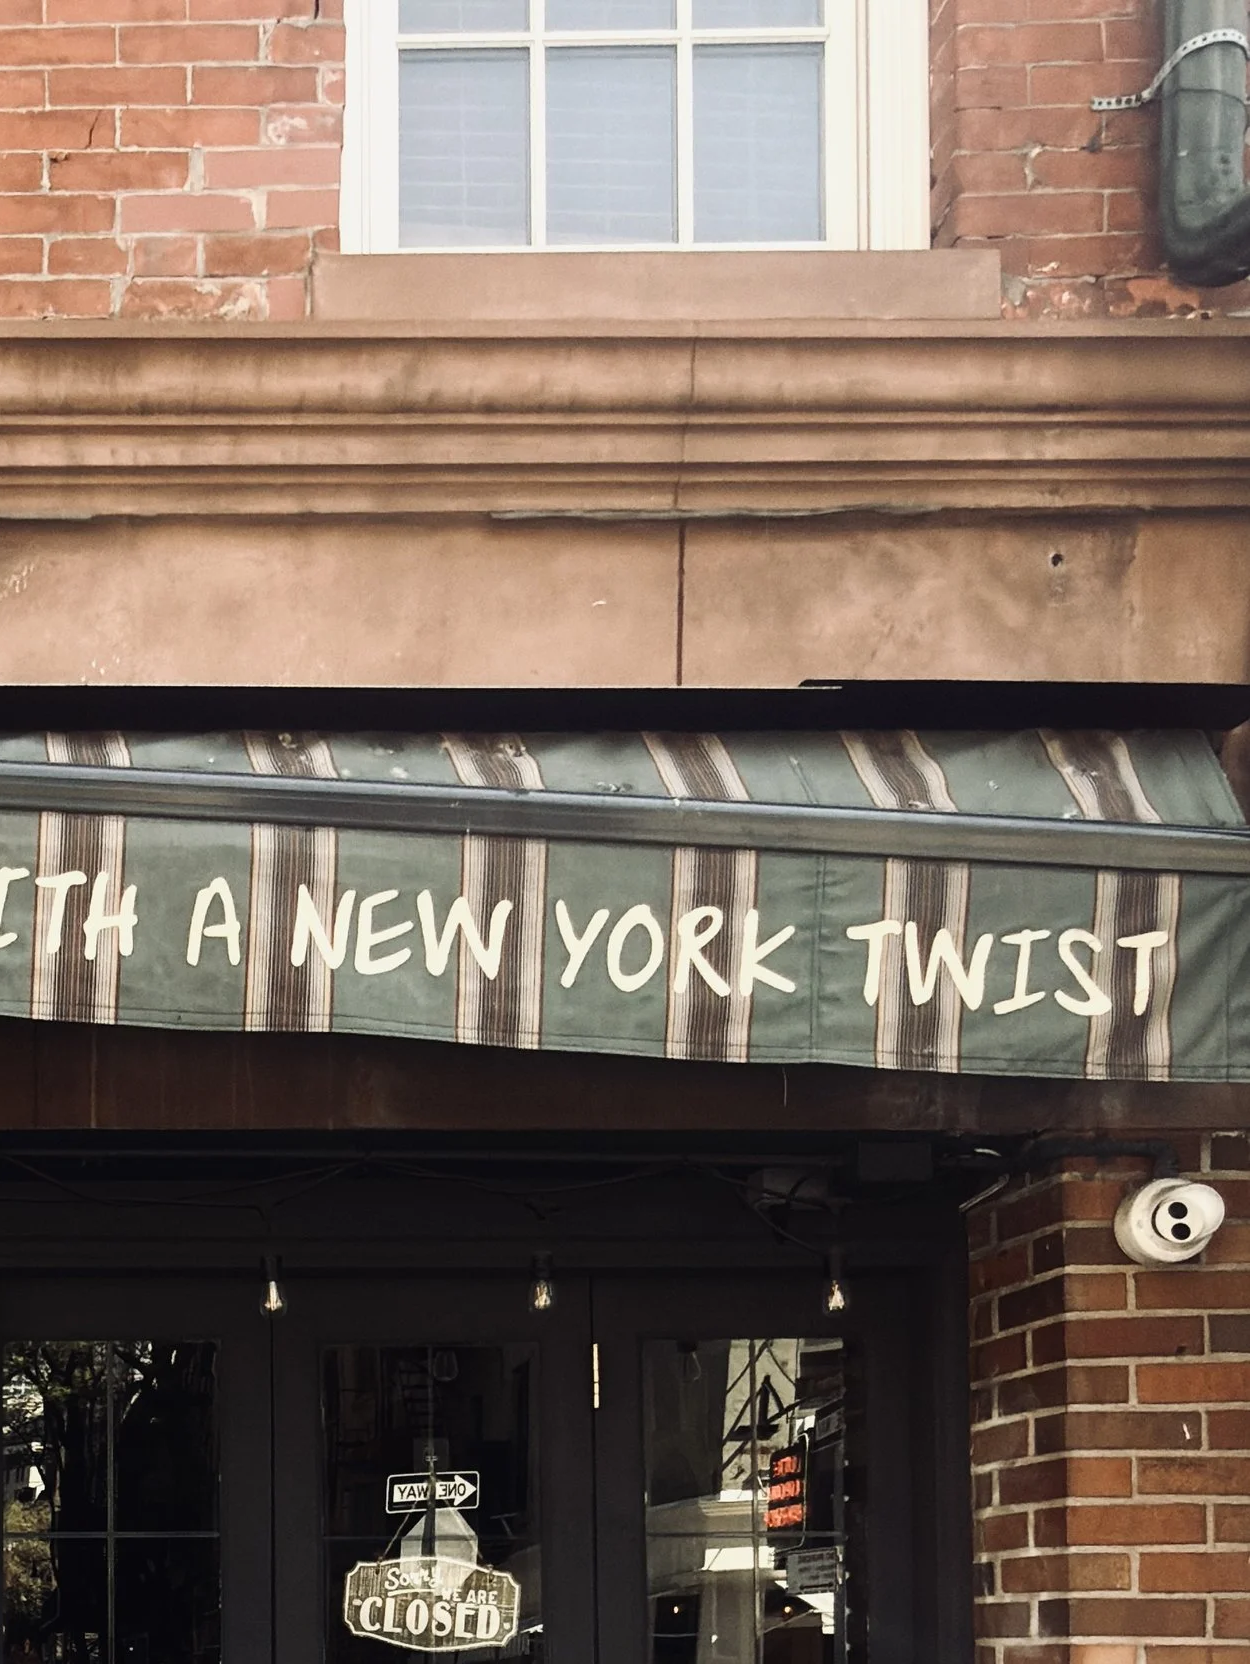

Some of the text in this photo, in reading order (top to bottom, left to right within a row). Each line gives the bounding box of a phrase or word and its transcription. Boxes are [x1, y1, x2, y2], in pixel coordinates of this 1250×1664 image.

[186, 876, 241, 966] A
[291, 884, 512, 980] NEW
[555, 899, 796, 997] YORK
[846, 919, 1170, 1016] TWIST
[360, 1596, 500, 1639] CLOSED
[442, 1589, 498, 1605] WE ARE
